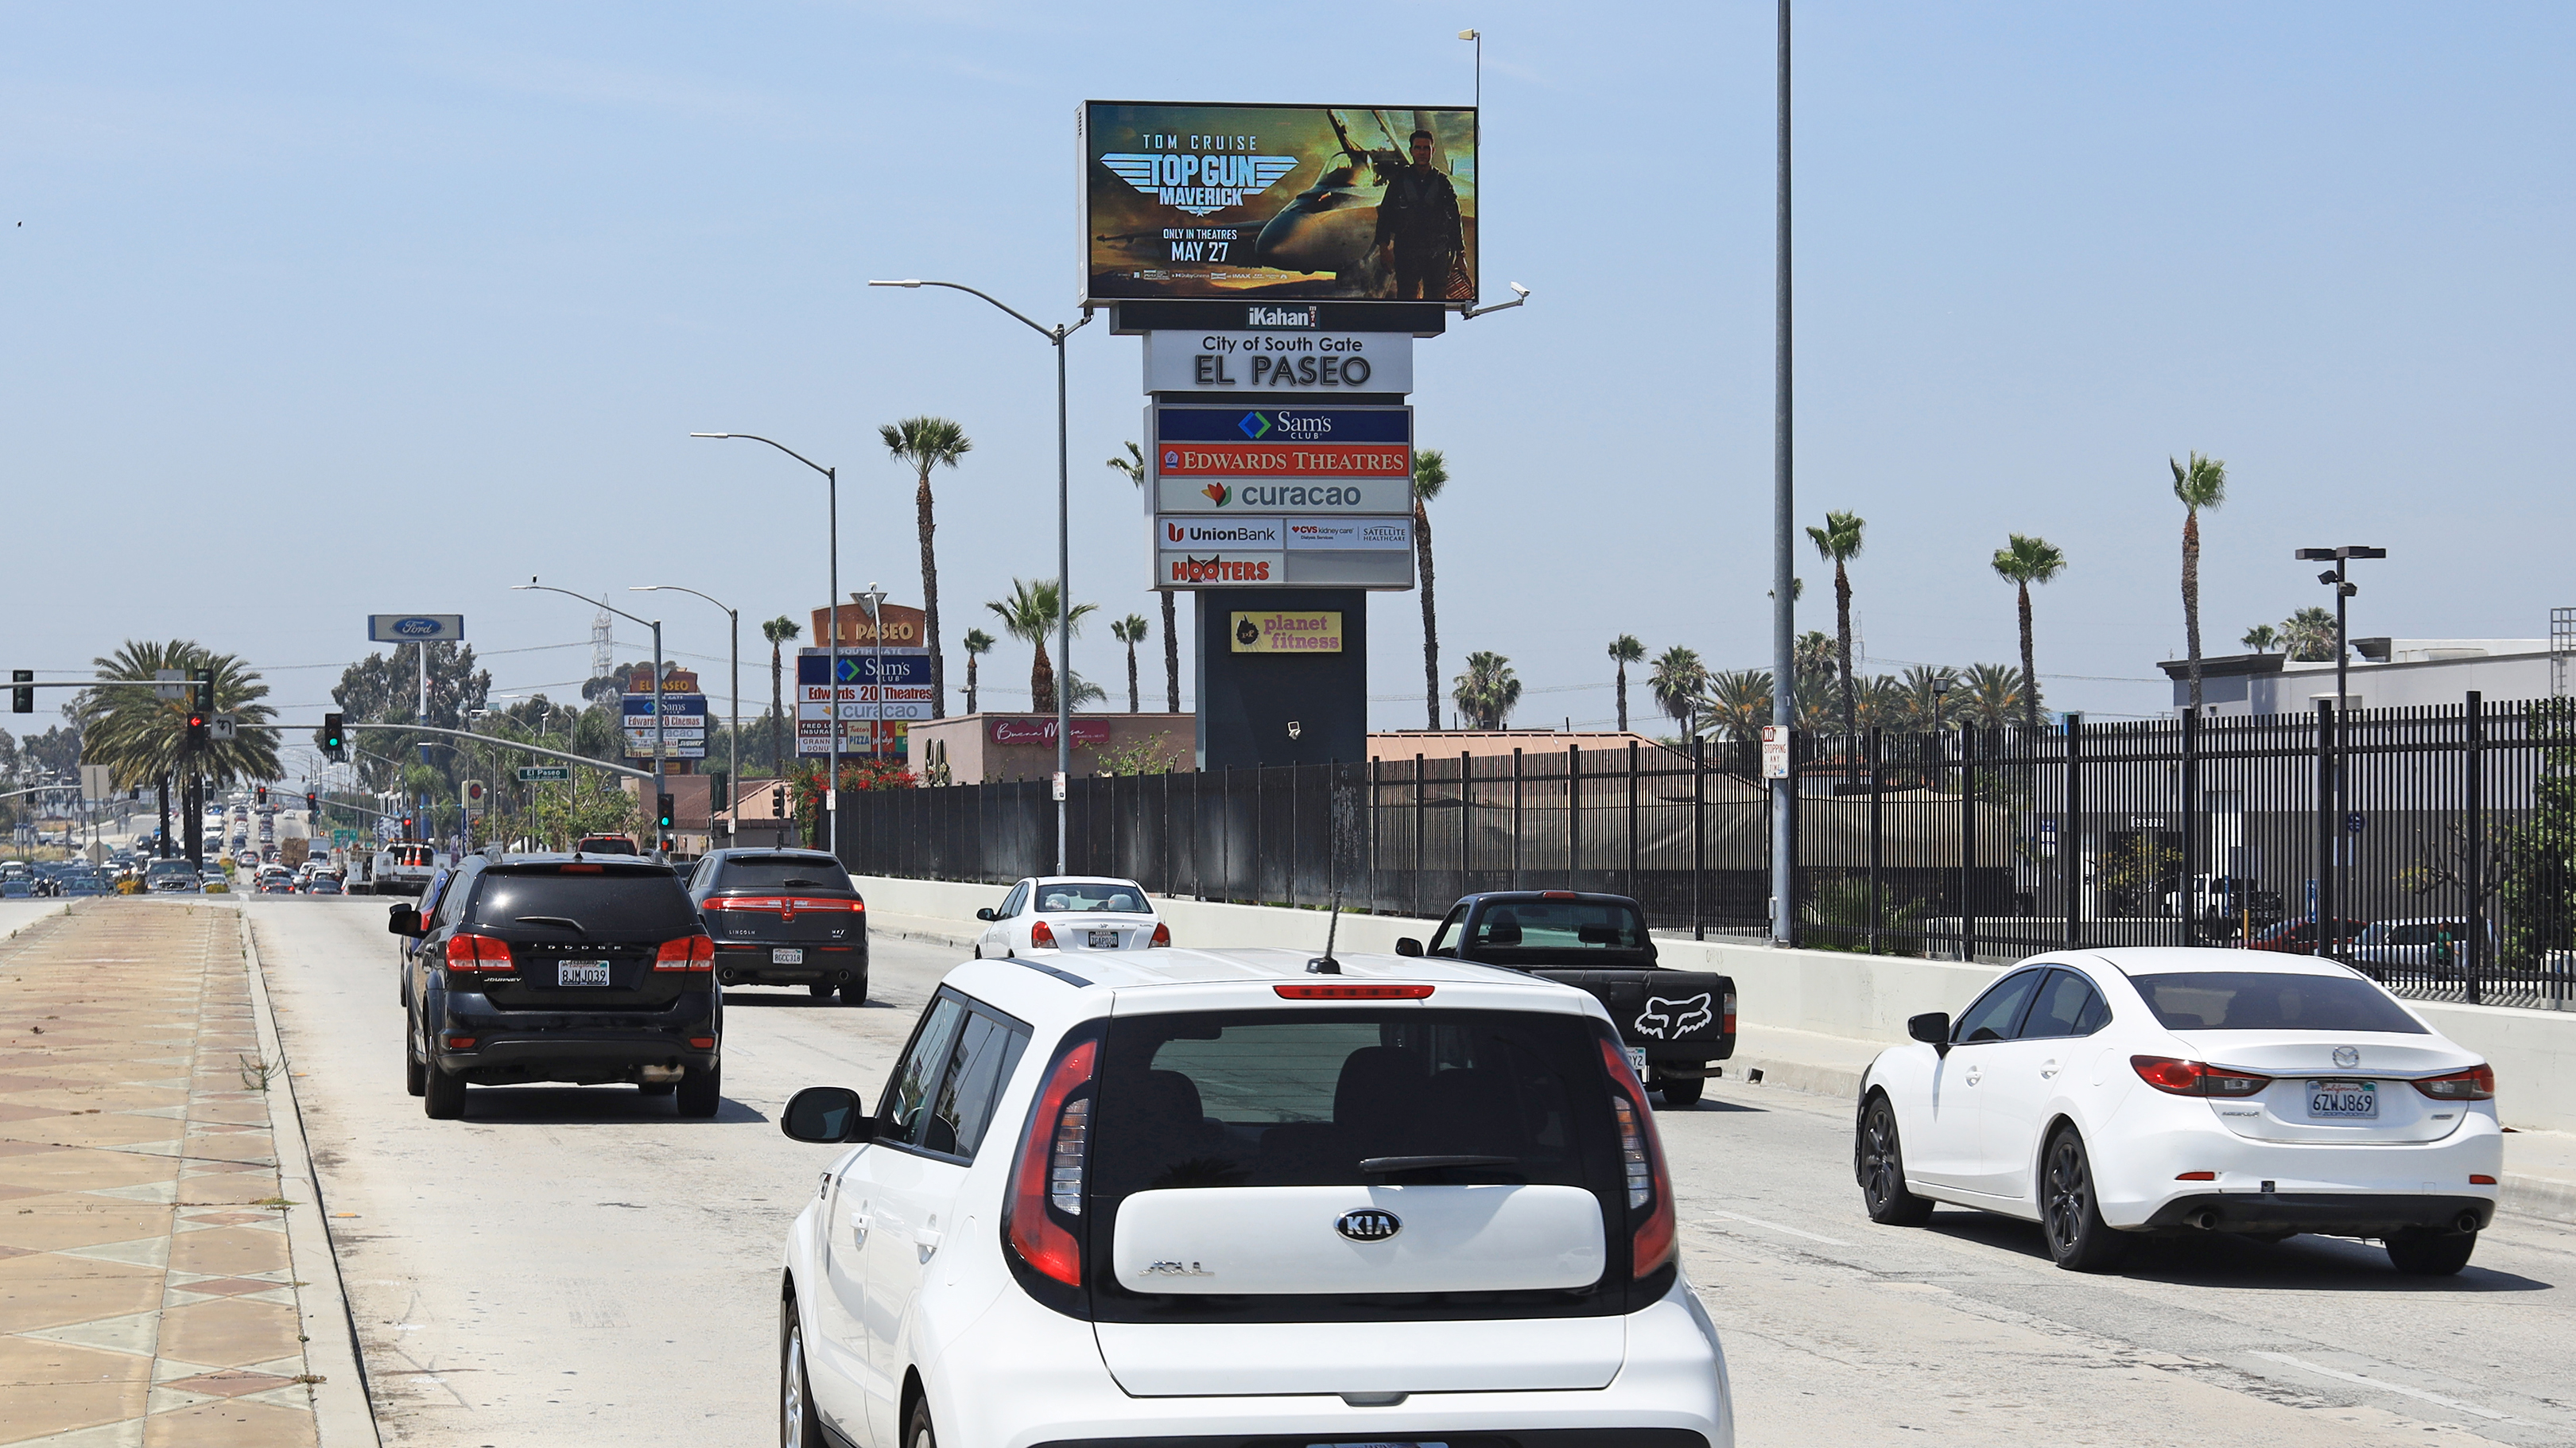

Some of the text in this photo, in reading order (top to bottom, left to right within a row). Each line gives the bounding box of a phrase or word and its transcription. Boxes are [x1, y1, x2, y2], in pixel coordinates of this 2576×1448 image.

[1143, 134, 1257, 150] TOM CRUISE
[1150, 153, 1255, 187] TOP GUN
[1159, 187, 1244, 206] MAVERICK
[1163, 228, 1237, 240] ONLY IN THEATRES
[1171, 241, 1228, 262] MAY 27
[1249, 307, 1309, 326] iKahan
[1202, 336, 1363, 353] City of South Gate
[1195, 354, 1371, 386] EL PASEO
[1278, 411, 1332, 433] Sam's
[1183, 451, 1404, 470] EDWARDS THEATRES
[1241, 486, 1361, 506] curacao
[1189, 526, 1275, 542] UnionBank
[1318, 526, 1339, 535] kidney
[1172, 560, 1270, 581] HOOTERS
[402, 620, 433, 634] Ford
[828, 622, 914, 640] L PASEO
[1263, 614, 1328, 635] planet
[1271, 632, 1340, 649] fitness
[639, 680, 689, 691] EL ASEO
[808, 685, 933, 701] Edwrds 20 Theatres
[671, 716, 700, 726] Cinemas
[996, 722, 1084, 740] Buena Msa
[1763, 728, 1774, 740] NO
[849, 736, 870, 745] PIZZA
[1764, 743, 1787, 754] STOPPING
[562, 969, 607, 982] 8JMJ039
[2322, 1083, 2365, 1094] California
[2312, 1093, 2373, 1112] 6ZWJ869
[1346, 1215, 1394, 1236] KIA
